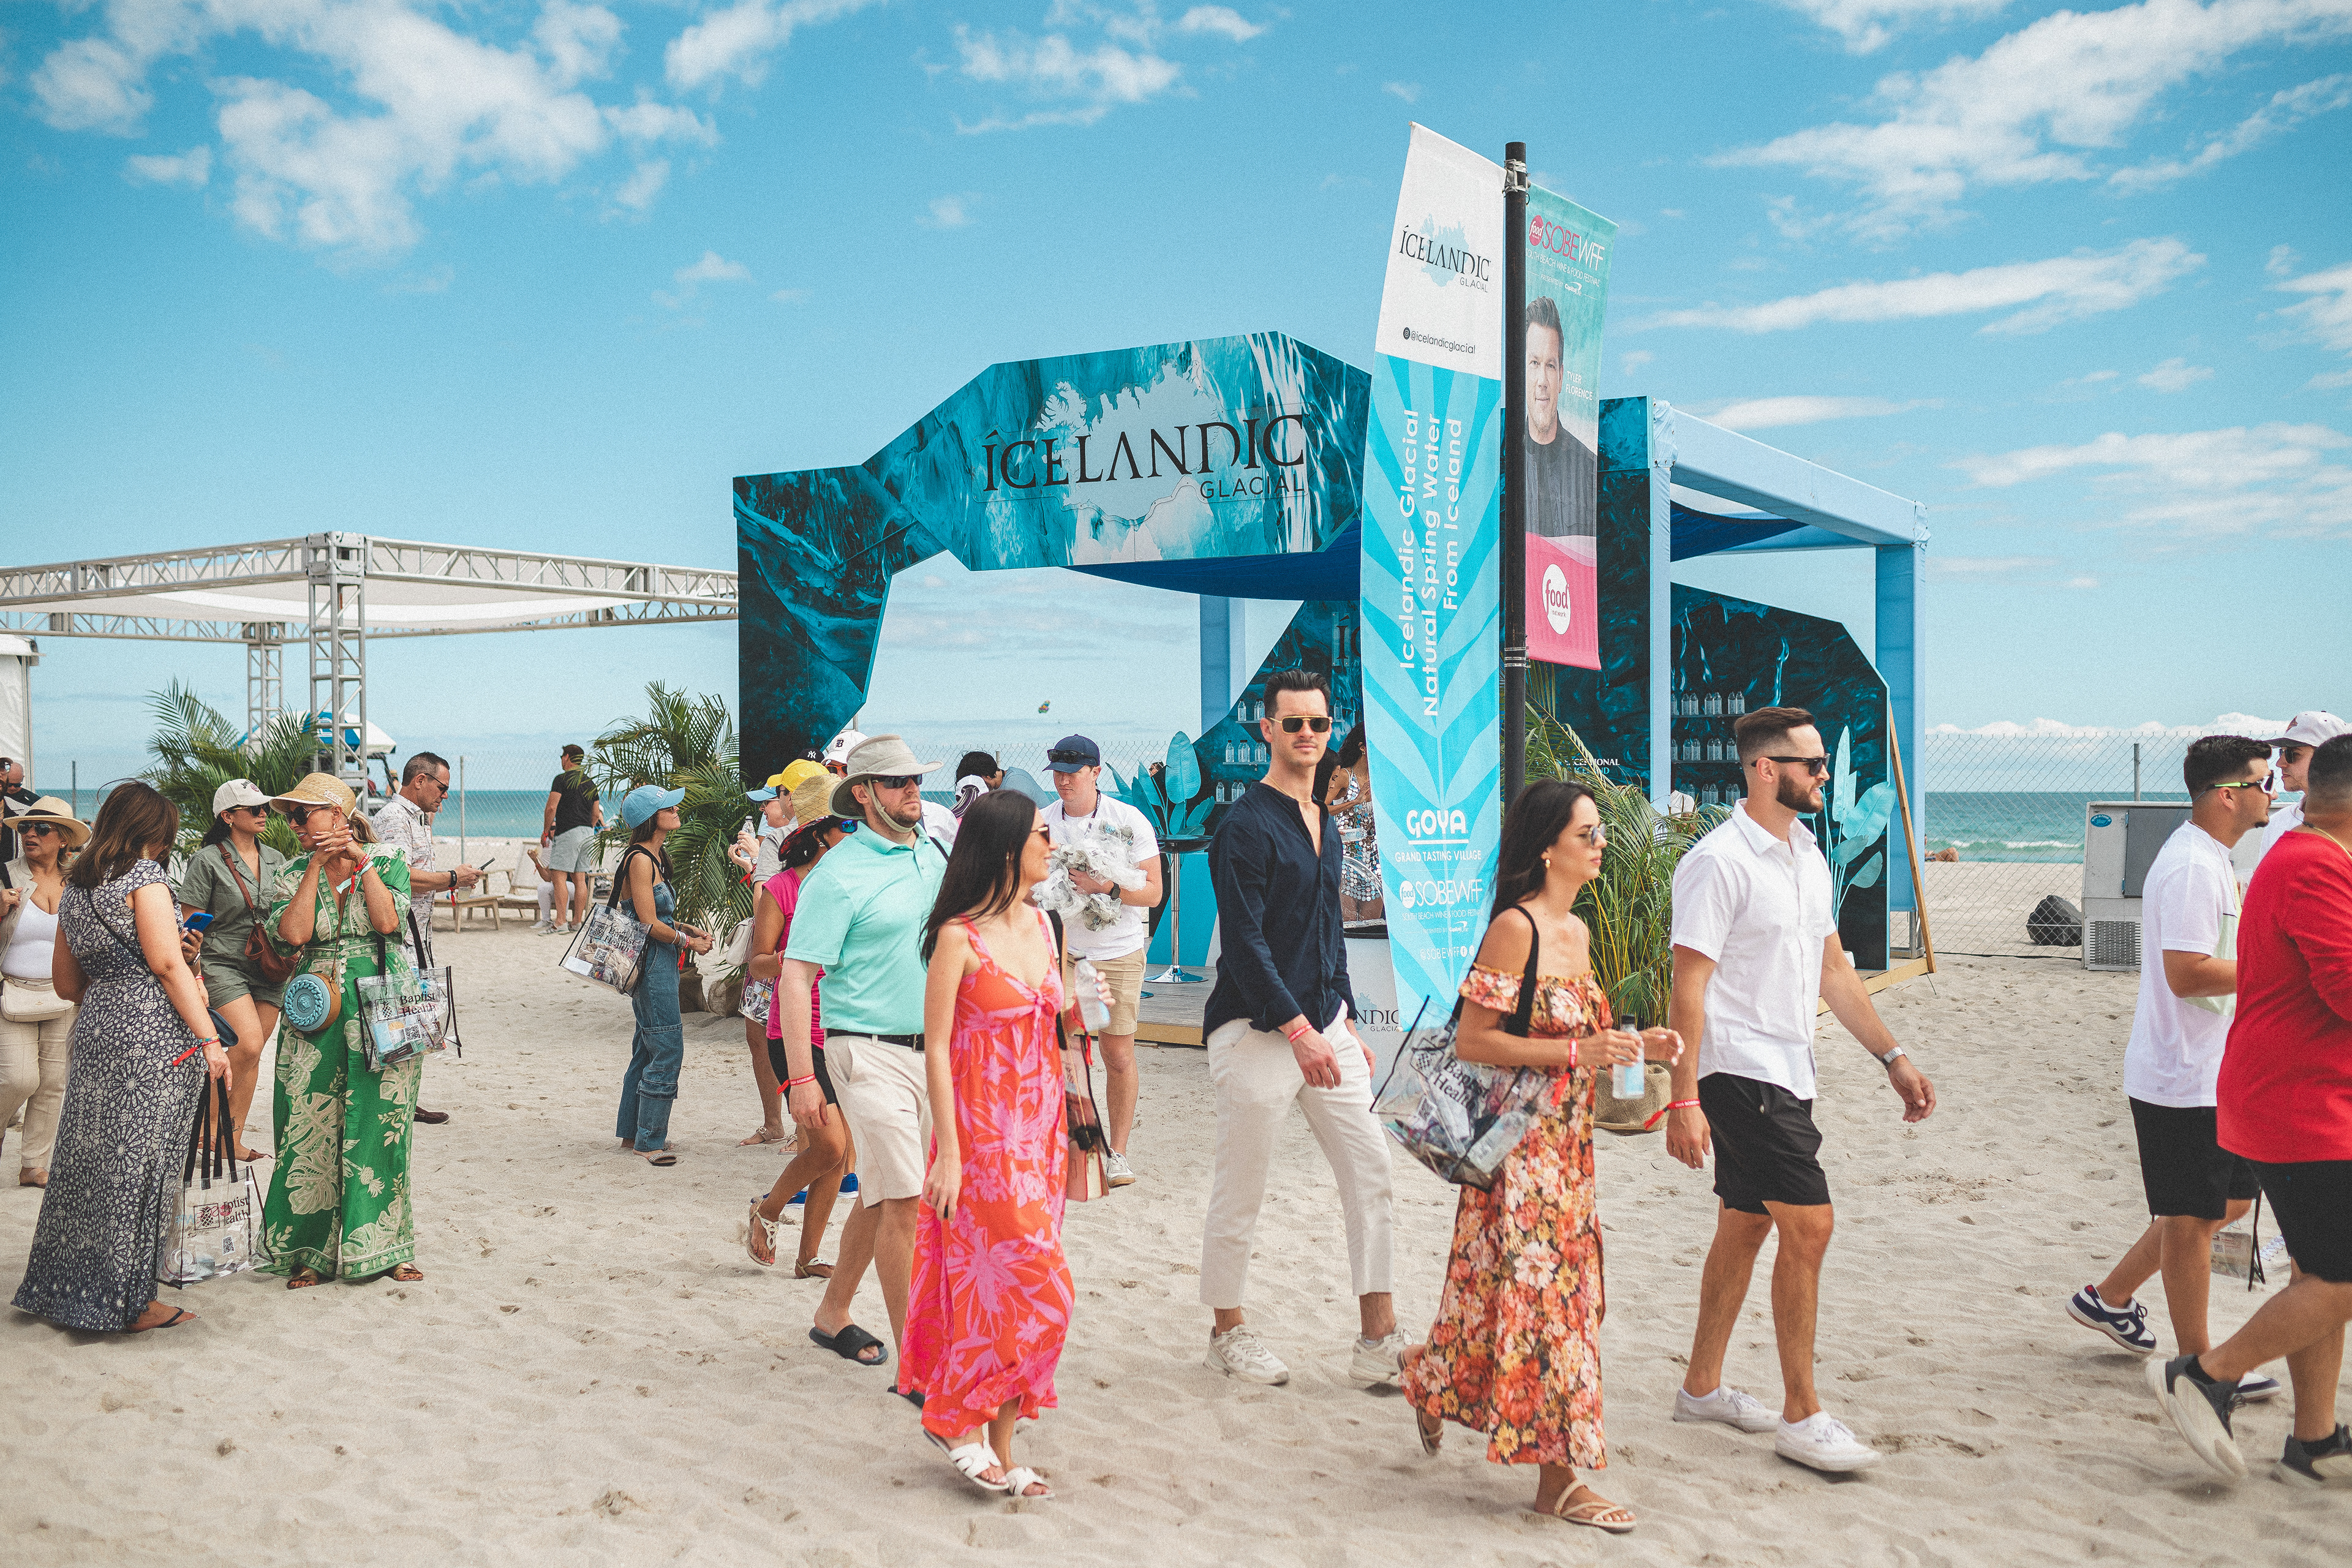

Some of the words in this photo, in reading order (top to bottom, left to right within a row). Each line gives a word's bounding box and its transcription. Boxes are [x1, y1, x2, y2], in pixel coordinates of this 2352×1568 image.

[1529, 221, 1544, 236] food
[1542, 221, 1605, 271] SOBEWFF
[1526, 248, 1540, 262] SOUTH
[1540, 255, 1556, 266] BEACH
[1556, 261, 1567, 273] WINE
[1570, 267, 1583, 279] FOOD
[1583, 273, 1600, 287] FESTIVAL
[1540, 274, 1559, 285] PRESENTED
[1460, 277, 1488, 293] GLACIAL
[1411, 330, 1476, 353] @icelandicglacial
[1566, 371, 1582, 384] TYLER
[1566, 383, 1593, 401] FLORENCE
[1400, 410, 1419, 518] Glacial
[1422, 413, 1440, 499] Water
[1444, 418, 1462, 530] Iceland
[1200, 475, 1305, 499] GLACIAL
[1422, 510, 1440, 601] Spring
[1443, 540, 1458, 610] From
[1398, 529, 1415, 668] Icelandic
[1545, 579, 1569, 614] food
[1421, 609, 1439, 716] Natural
[807, 750, 816, 759] NY
[1406, 810, 1466, 838] GOYA
[1395, 851, 1421, 862] GRAND
[1422, 850, 1452, 862] TASTING
[1453, 850, 1482, 861] VILLAGE
[1401, 886, 1414, 902] food
[1415, 879, 1483, 907] SOBEWFF
[1402, 912, 1417, 921] SOUTH
[1434, 910, 1447, 919] WINE
[609, 926, 636, 945] Baptist
[1420, 946, 1460, 960] @SOBEWFF
[400, 991, 436, 1005] Baptist
[401, 1002, 435, 1017] Health
